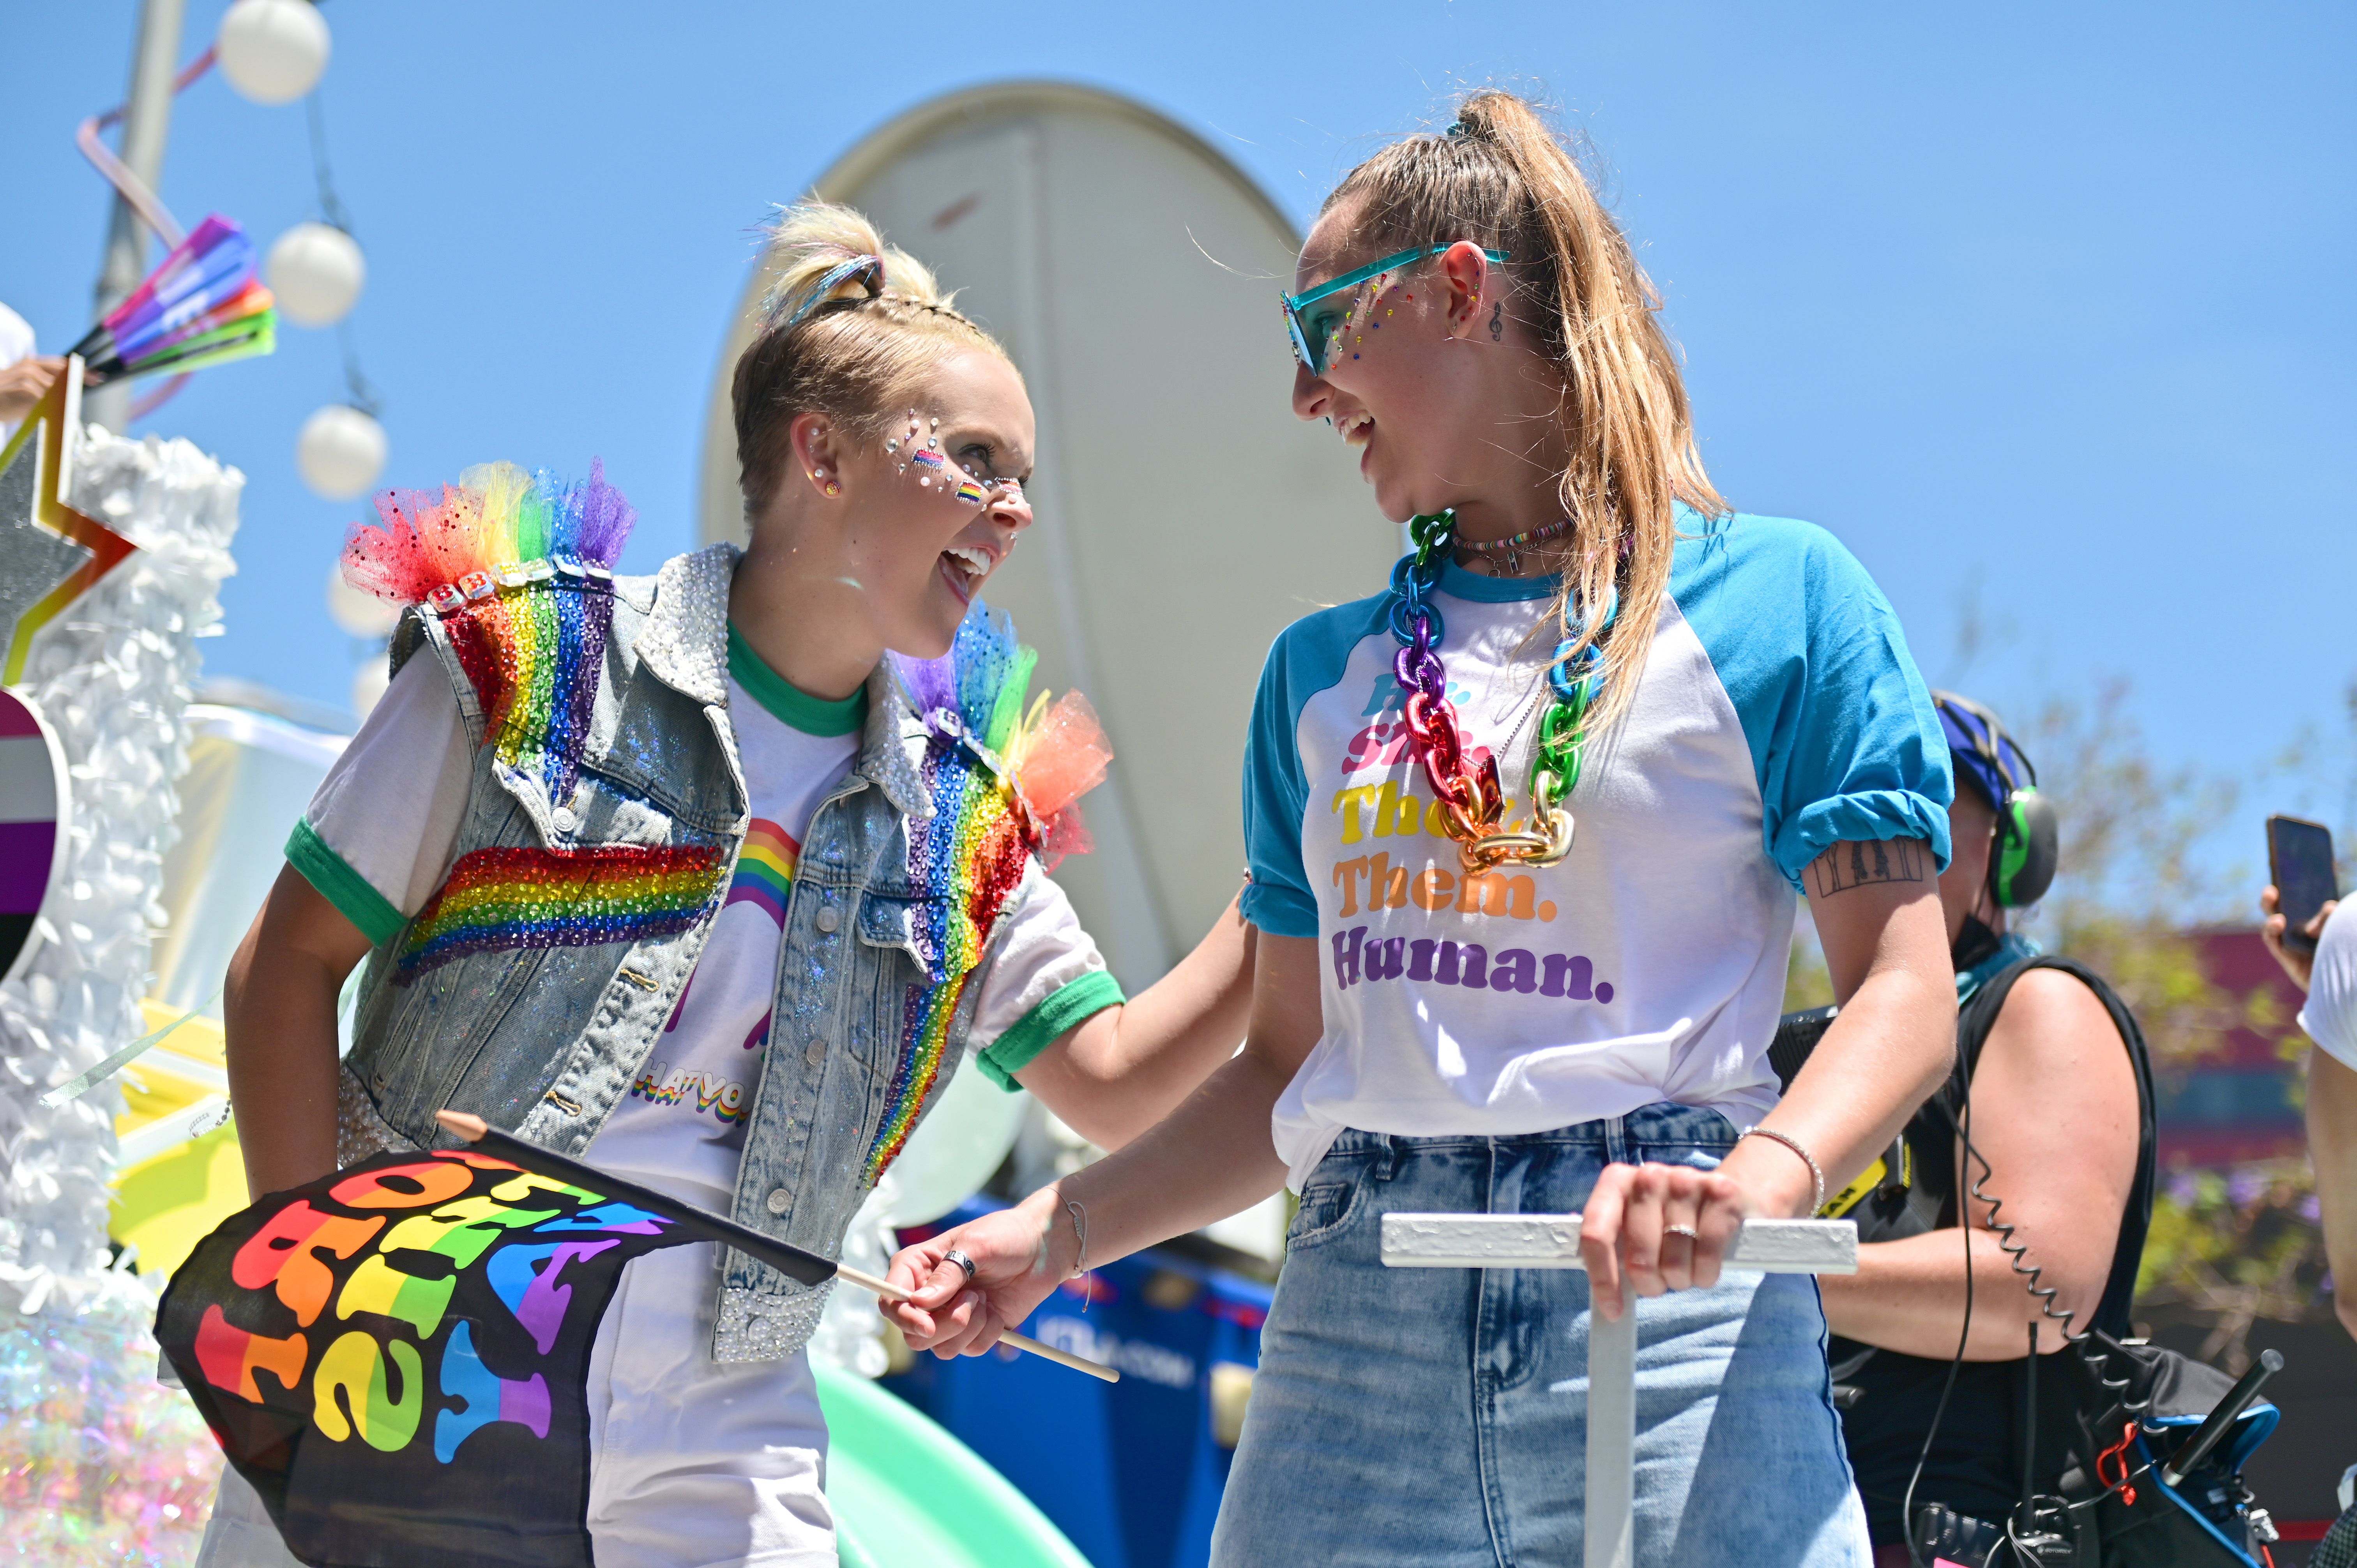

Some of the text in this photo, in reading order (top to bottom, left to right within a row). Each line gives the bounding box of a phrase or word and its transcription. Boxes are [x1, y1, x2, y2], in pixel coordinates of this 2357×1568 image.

[1361, 673, 1471, 717] H.
[1342, 722, 1490, 775] Sh.
[1332, 780, 1525, 844] Th.
[1333, 851, 1557, 922] Them.
[1331, 926, 1614, 1004] Human.
